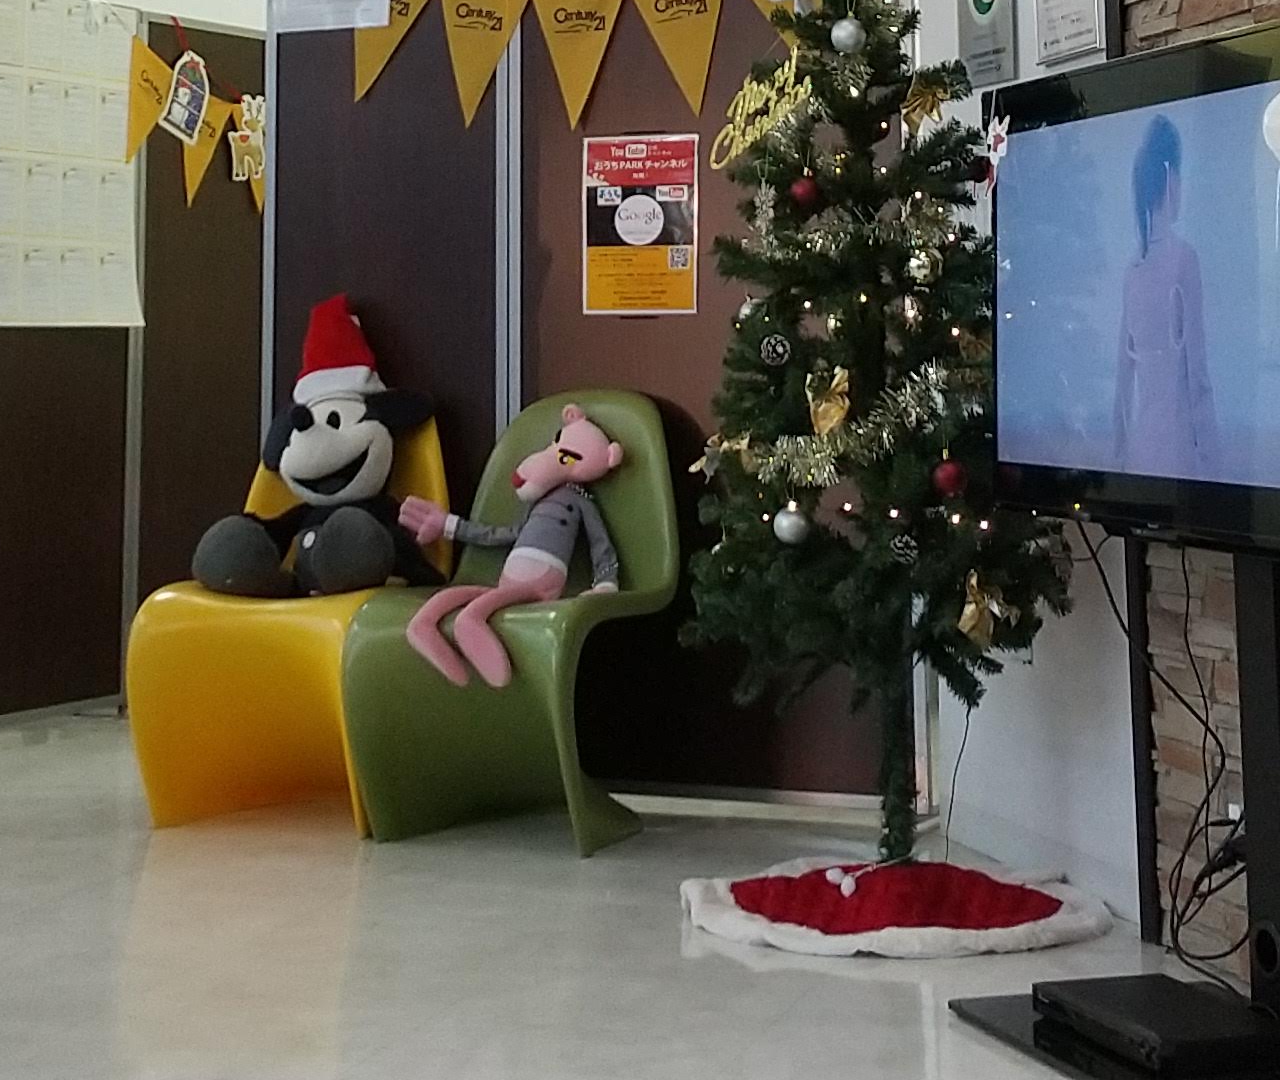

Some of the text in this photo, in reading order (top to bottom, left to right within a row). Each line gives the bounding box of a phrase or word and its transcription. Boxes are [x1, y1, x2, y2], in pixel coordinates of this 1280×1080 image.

[456, 2, 502, 32] Century 21
[554, 7, 605, 31] Century 21
[617, 207, 663, 226] Google
